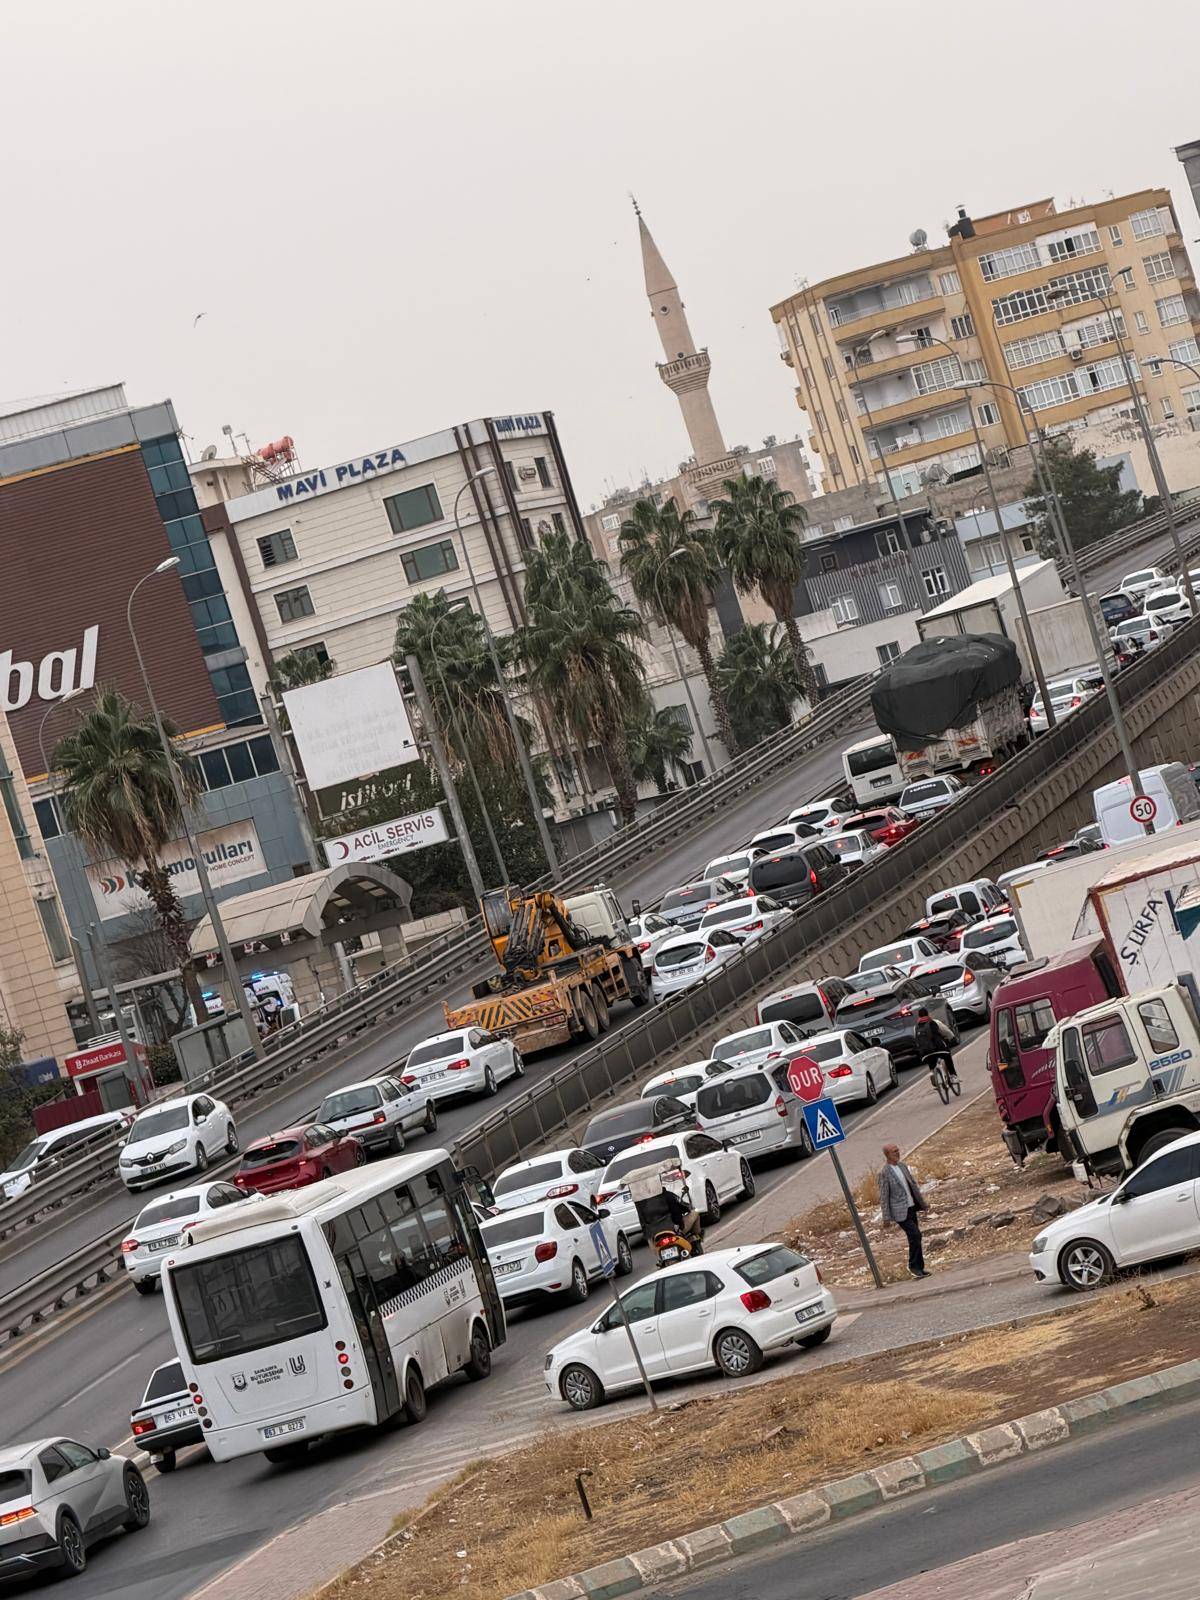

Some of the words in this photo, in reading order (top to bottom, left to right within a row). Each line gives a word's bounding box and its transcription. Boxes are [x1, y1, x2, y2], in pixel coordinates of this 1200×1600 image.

[515, 415, 541, 430] PLAZA
[276, 469, 327, 501] MAVİ
[335, 449, 406, 482] PLAZA
[1135, 802, 1152, 817] 50
[353, 829, 385, 850] ACİL
[386, 815, 435, 840] SERVİS
[377, 834, 414, 850] EMERGENCY
[210, 863, 228, 872] HOME
[228, 854, 255, 868] CONCEPT
[82, 1056, 99, 1067] Ziraat
[99, 1050, 121, 1062] Bankası
[1149, 1049, 1192, 1071] 2520
[790, 1067, 821, 1091] DUR
